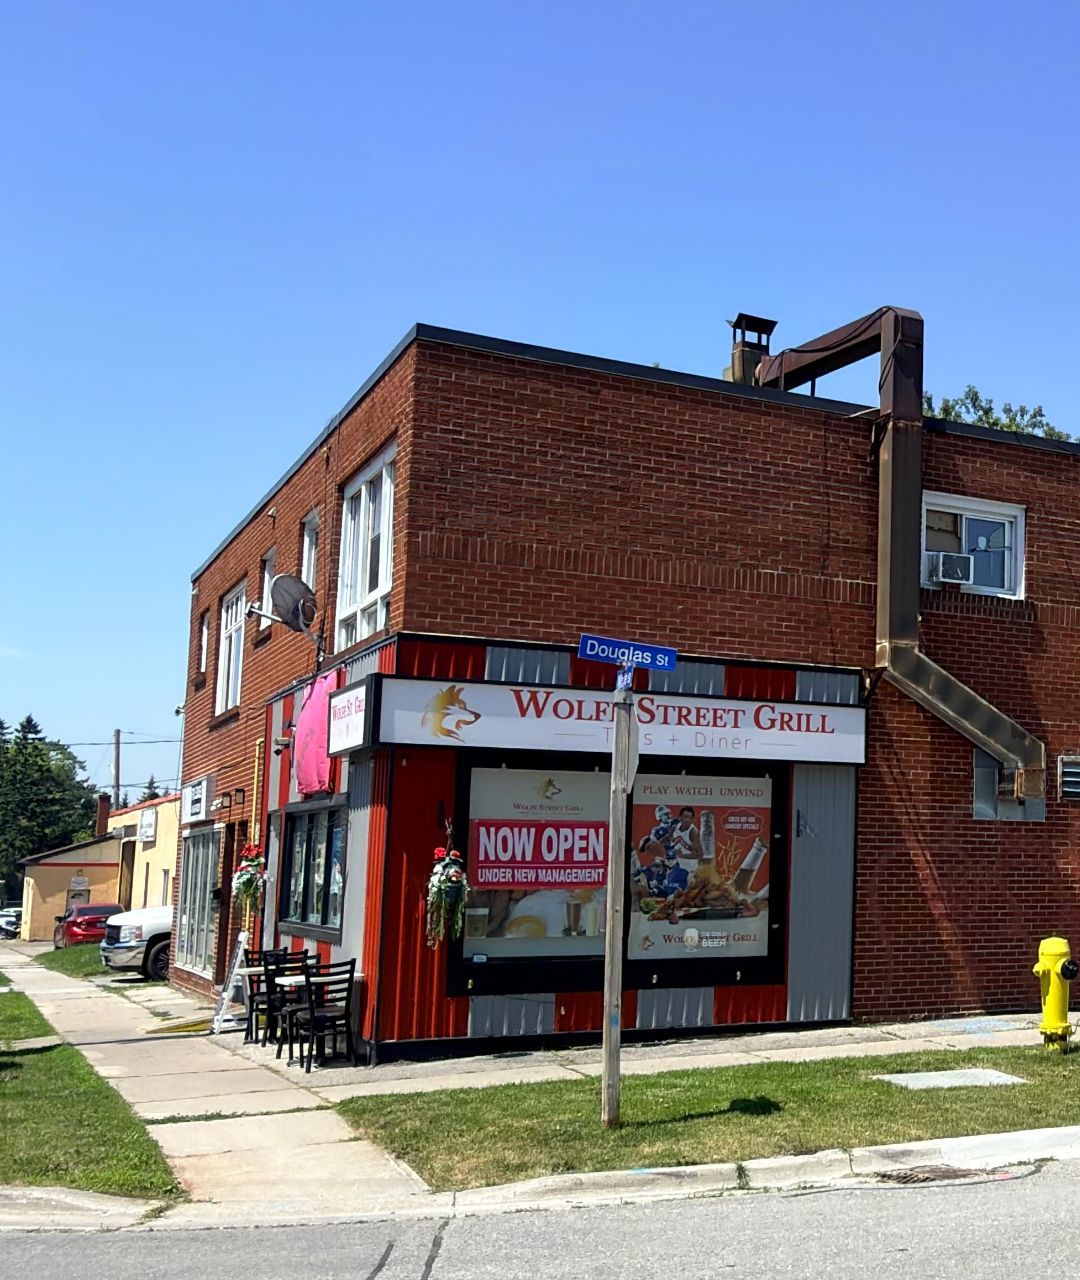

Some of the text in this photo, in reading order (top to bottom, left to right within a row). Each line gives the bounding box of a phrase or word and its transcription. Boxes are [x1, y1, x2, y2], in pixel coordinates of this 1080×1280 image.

[586, 639, 669, 667] Douglas St
[637, 696, 746, 729] STREET
[753, 704, 835, 734] GRILL
[695, 731, 752, 751] Diner
[643, 785, 763, 798] PLAY WATCH UNWIND
[479, 826, 605, 861] NOW OPEN
[478, 868, 605, 883] UNDER NEW MANAGEMENT
[702, 939, 727, 948] BEER
